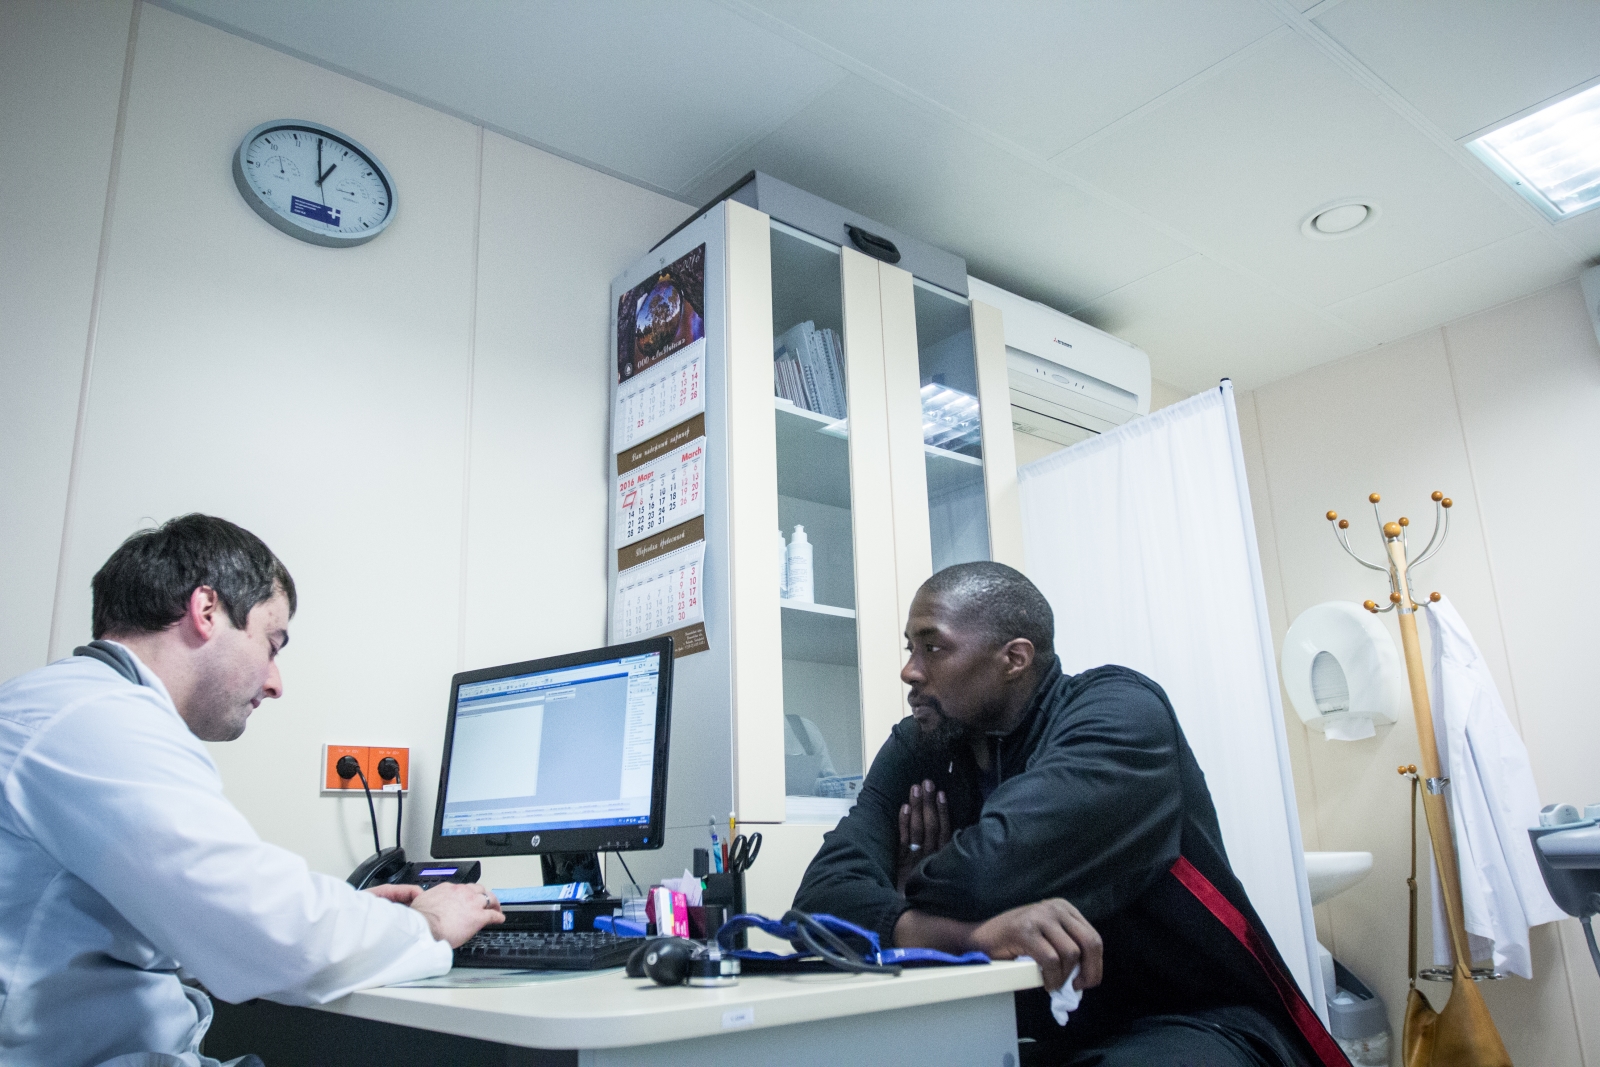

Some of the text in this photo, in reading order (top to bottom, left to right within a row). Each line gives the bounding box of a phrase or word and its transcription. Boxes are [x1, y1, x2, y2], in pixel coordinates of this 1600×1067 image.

[270, 144, 278, 152] 10
[295, 140, 301, 148] 11
[255, 160, 261, 168] 9
[360, 171, 366, 179] 2
[266, 188, 272, 197] 8
[680, 388, 686, 397] 20
[637, 420, 644, 428] 23
[680, 398, 686, 406] 27
[691, 391, 697, 400] 28
[620, 446, 702, 492] 2016 Март March
[660, 488, 666, 496] 10
[670, 483, 676, 491] 11
[692, 473, 699, 481] 13
[638, 506, 644, 514] 15
[681, 488, 687, 496] 19
[692, 482, 698, 491] 20
[628, 492, 698, 529] 21 22 23 24 25 26 27
[627, 516, 664, 538] 28 29 30 31
[678, 602, 685, 610] 23
[689, 598, 696, 607] 24
[678, 612, 685, 620] 30
